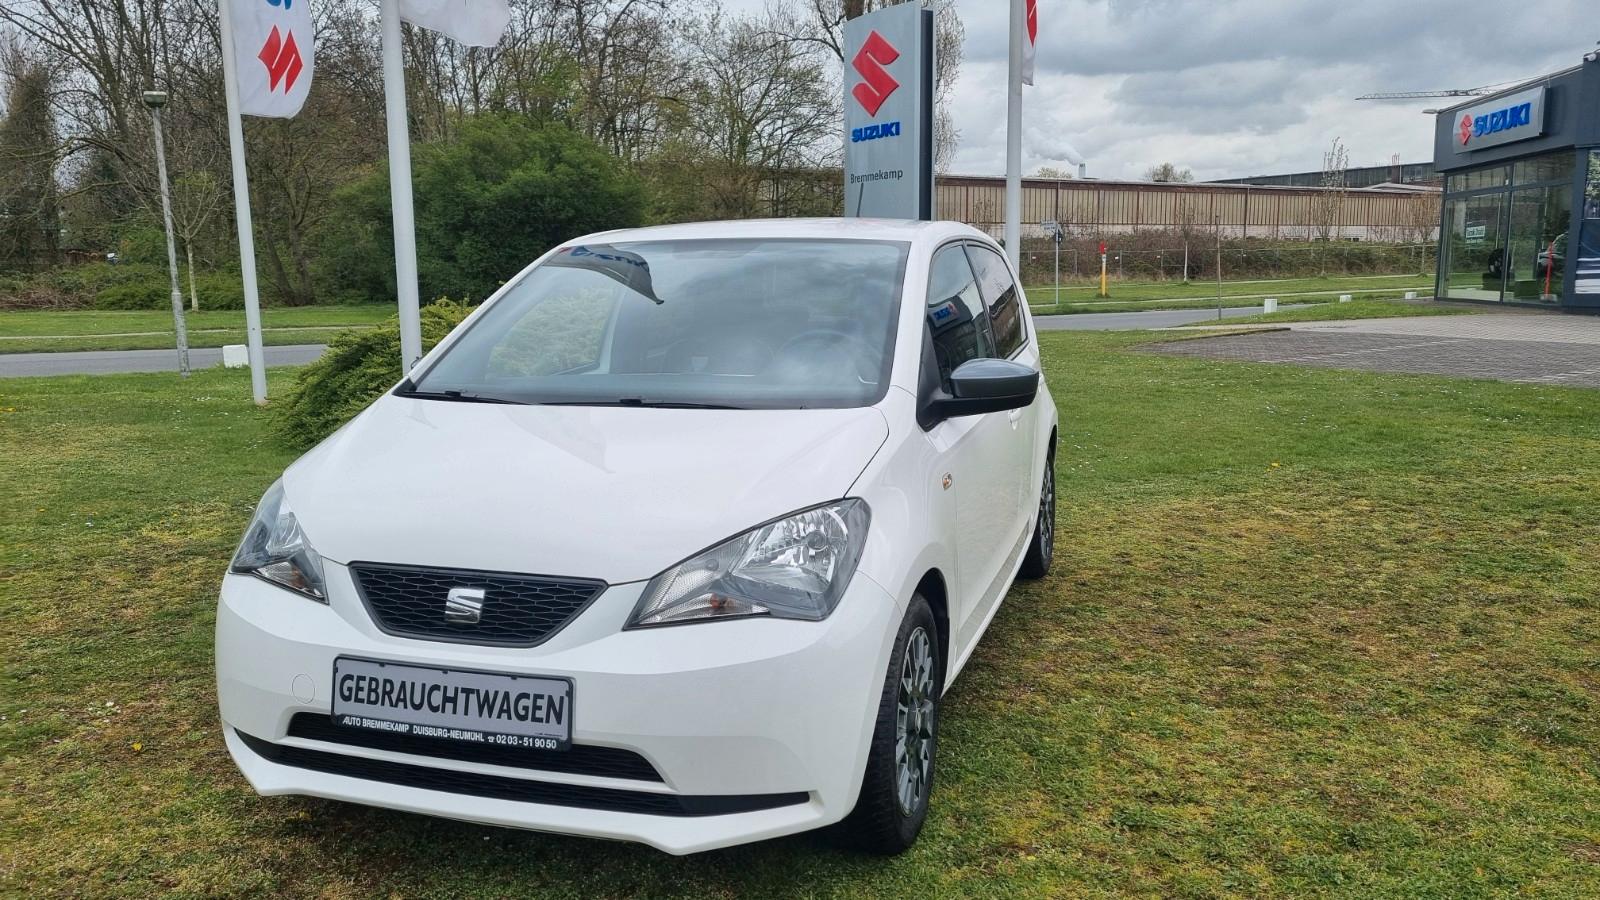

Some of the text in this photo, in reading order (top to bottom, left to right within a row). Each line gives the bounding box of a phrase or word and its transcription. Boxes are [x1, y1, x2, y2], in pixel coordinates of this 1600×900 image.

[1472, 102, 1531, 138] SUZUKI
[851, 121, 900, 143] SUZUKI
[850, 169, 904, 184] Bremmekamp
[339, 673, 565, 725] GEBRAUCHTWAGEN
[342, 716, 361, 727] AUTO
[362, 718, 410, 733] BREMMEKAMP
